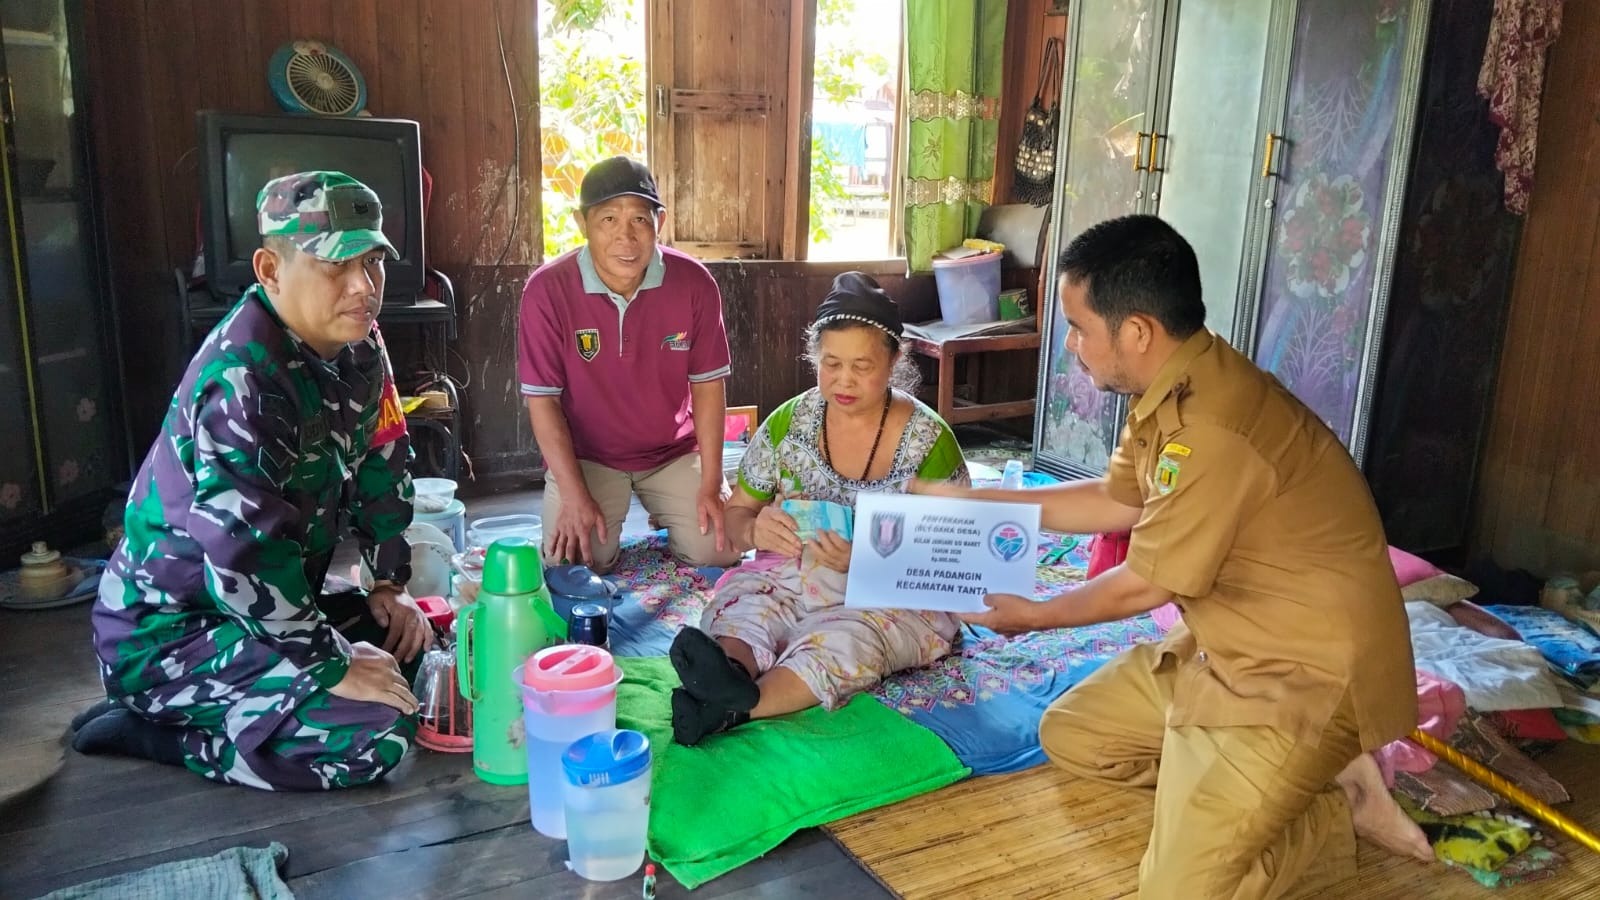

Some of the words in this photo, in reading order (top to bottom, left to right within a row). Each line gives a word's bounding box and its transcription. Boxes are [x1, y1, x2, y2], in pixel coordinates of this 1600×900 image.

[906, 568, 931, 577] DESA
[933, 569, 982, 581] PADANGIN
[896, 579, 955, 592] KECAMATAN
[957, 585, 988, 595] TANTA
